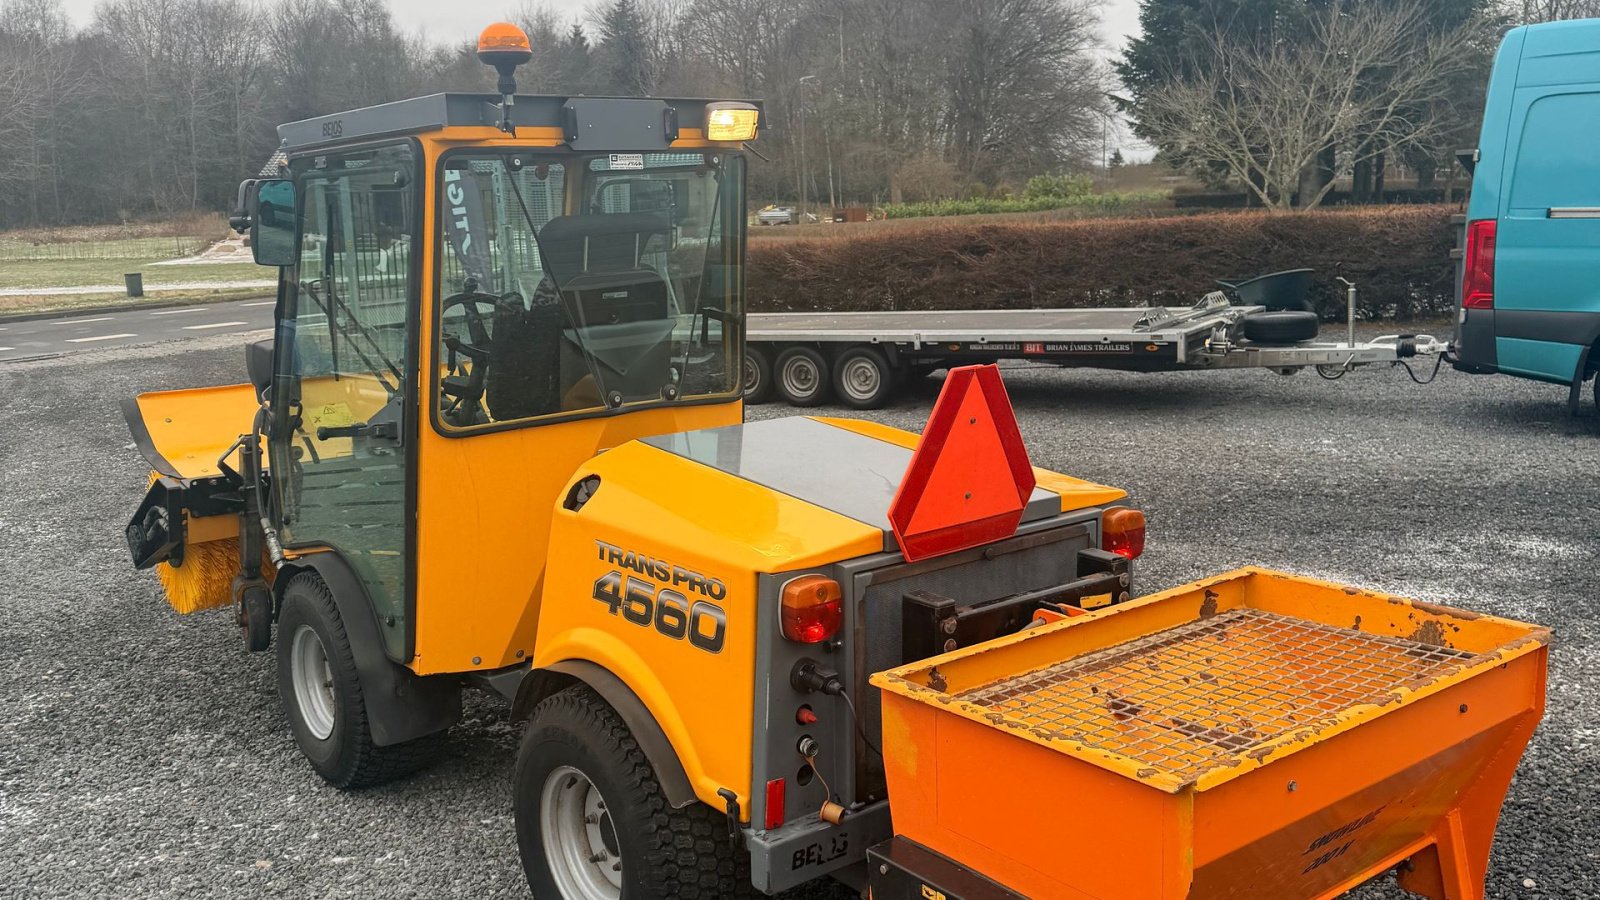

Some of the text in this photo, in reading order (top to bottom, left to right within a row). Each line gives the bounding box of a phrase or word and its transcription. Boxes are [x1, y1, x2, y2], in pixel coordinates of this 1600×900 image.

[1046, 343, 1130, 352] BRIAN JAMES TRAILERS
[592, 569, 727, 655] 4560
